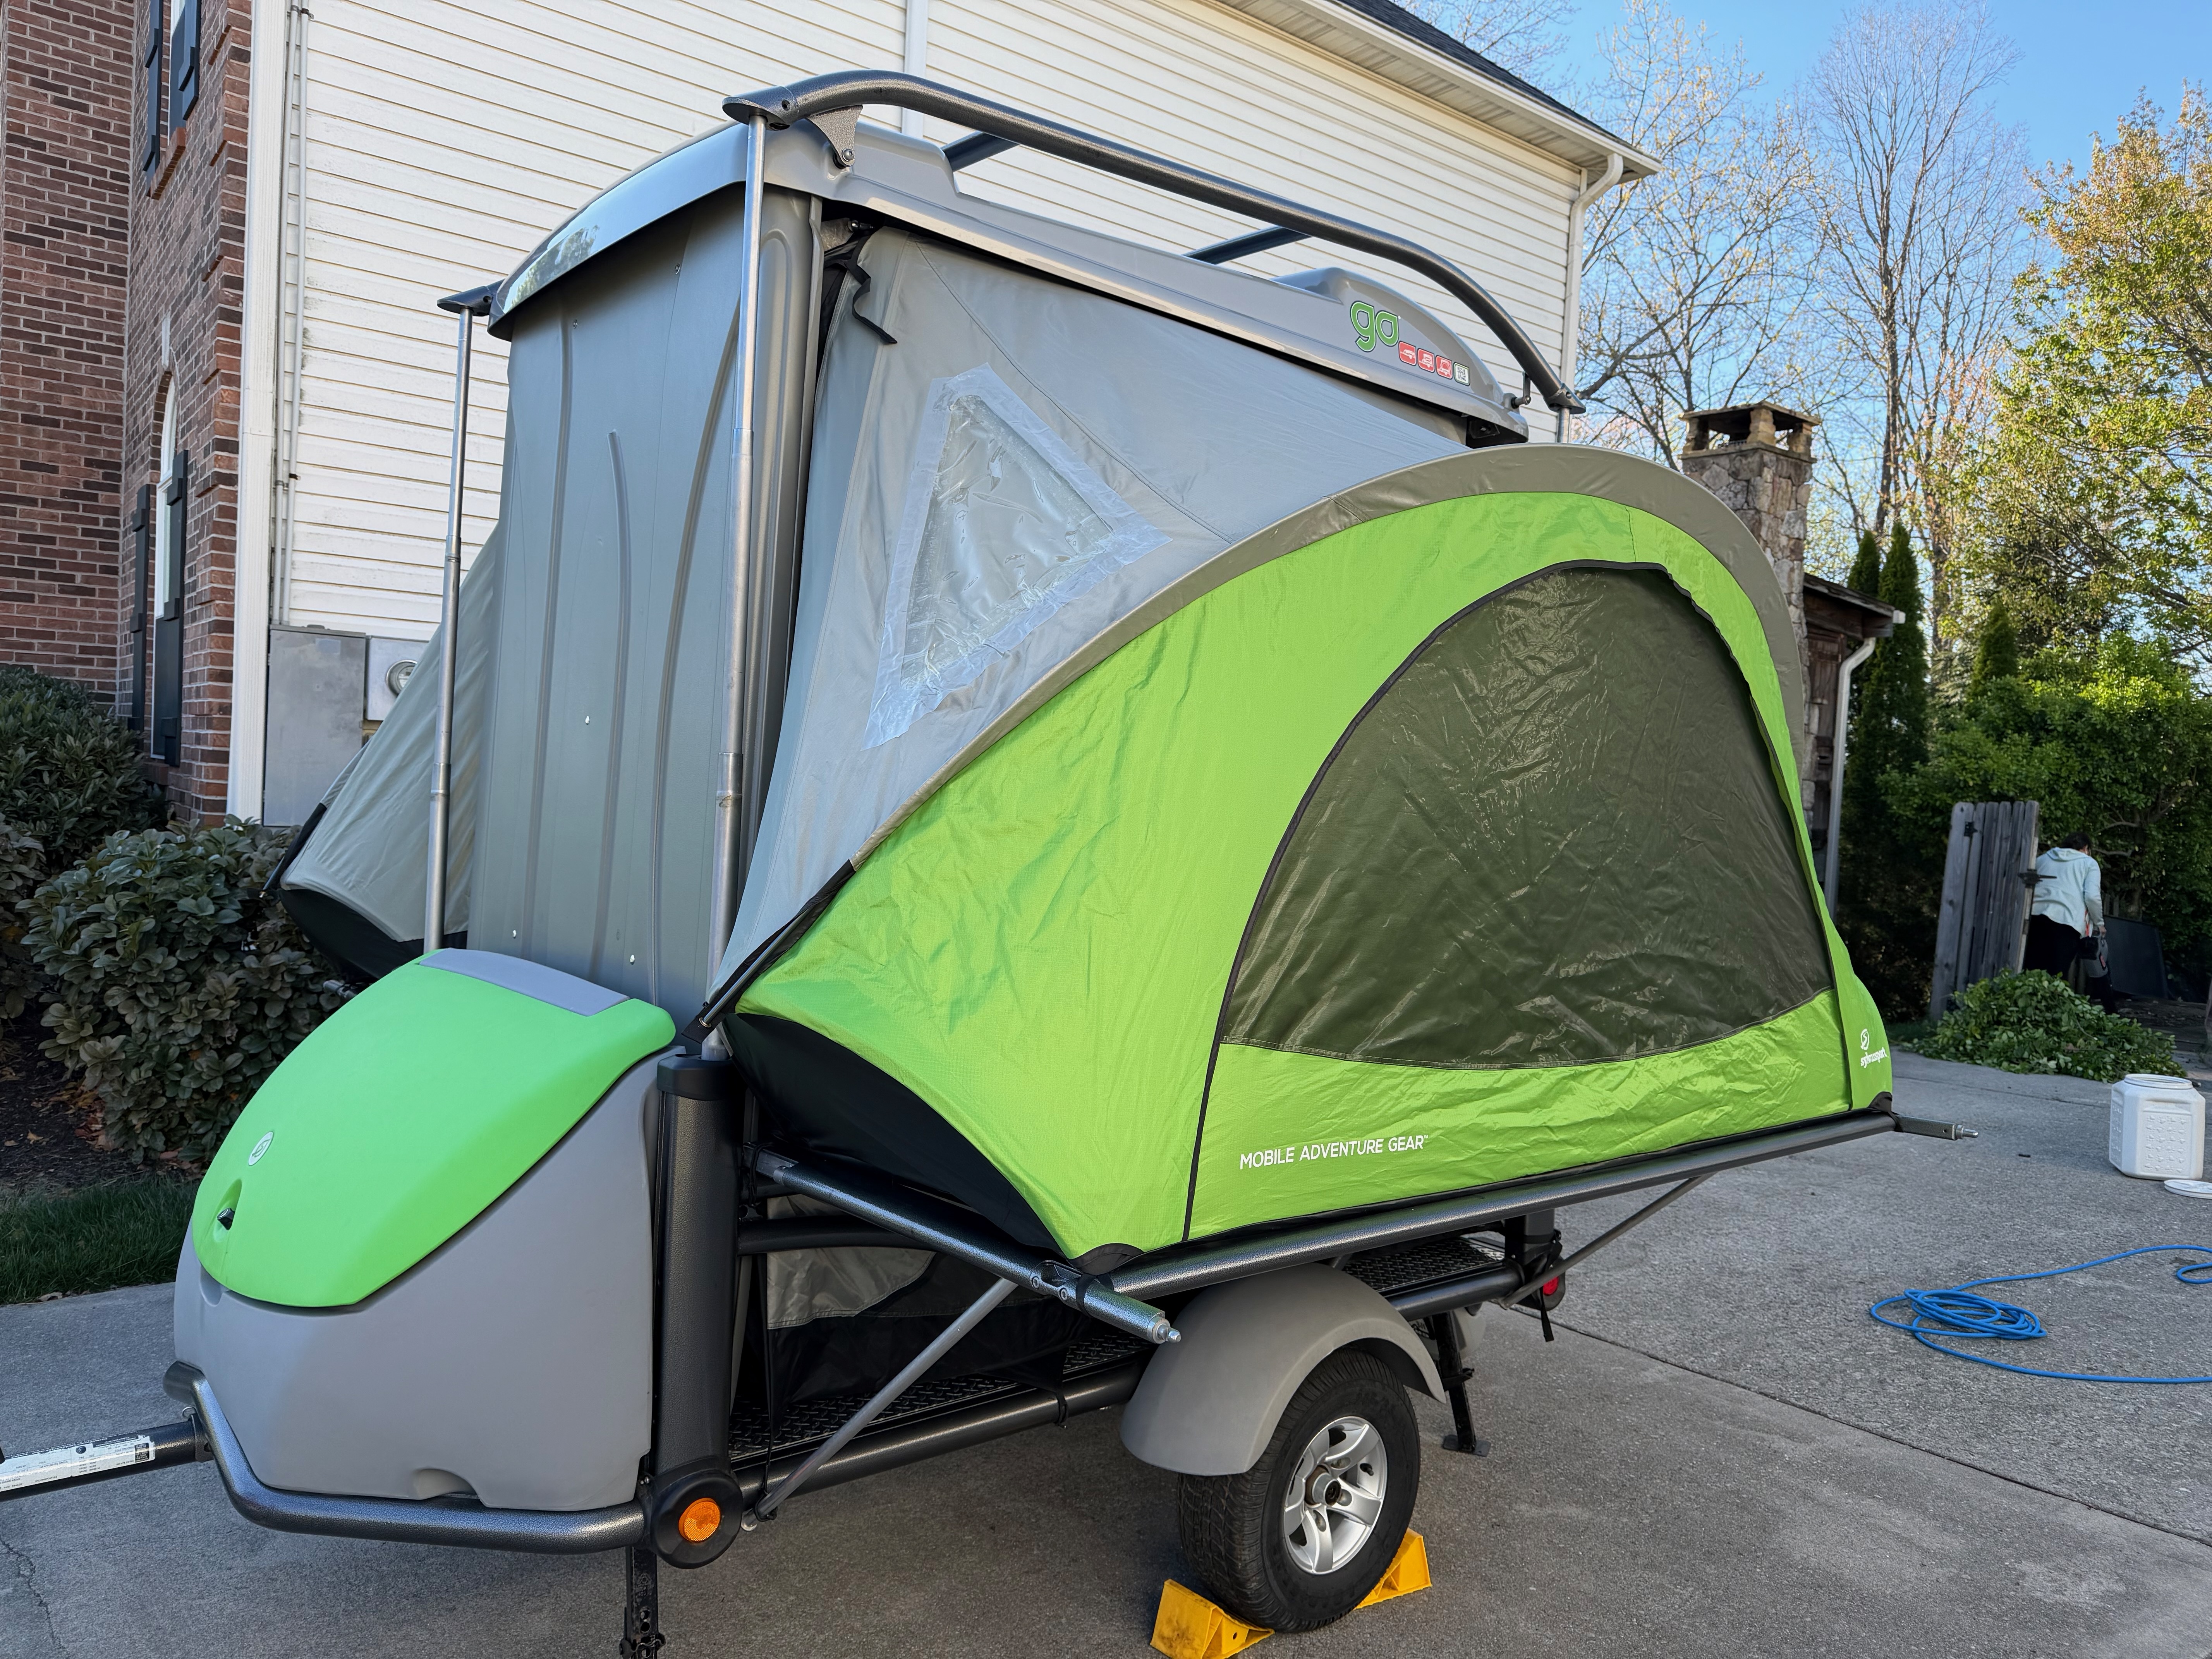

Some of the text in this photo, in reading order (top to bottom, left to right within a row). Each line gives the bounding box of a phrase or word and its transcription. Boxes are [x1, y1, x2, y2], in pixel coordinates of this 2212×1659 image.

[1350, 301, 1399, 352] go
[1240, 1147, 1295, 1170] MOBILE
[1299, 1139, 1384, 1161] ADVENTURE
